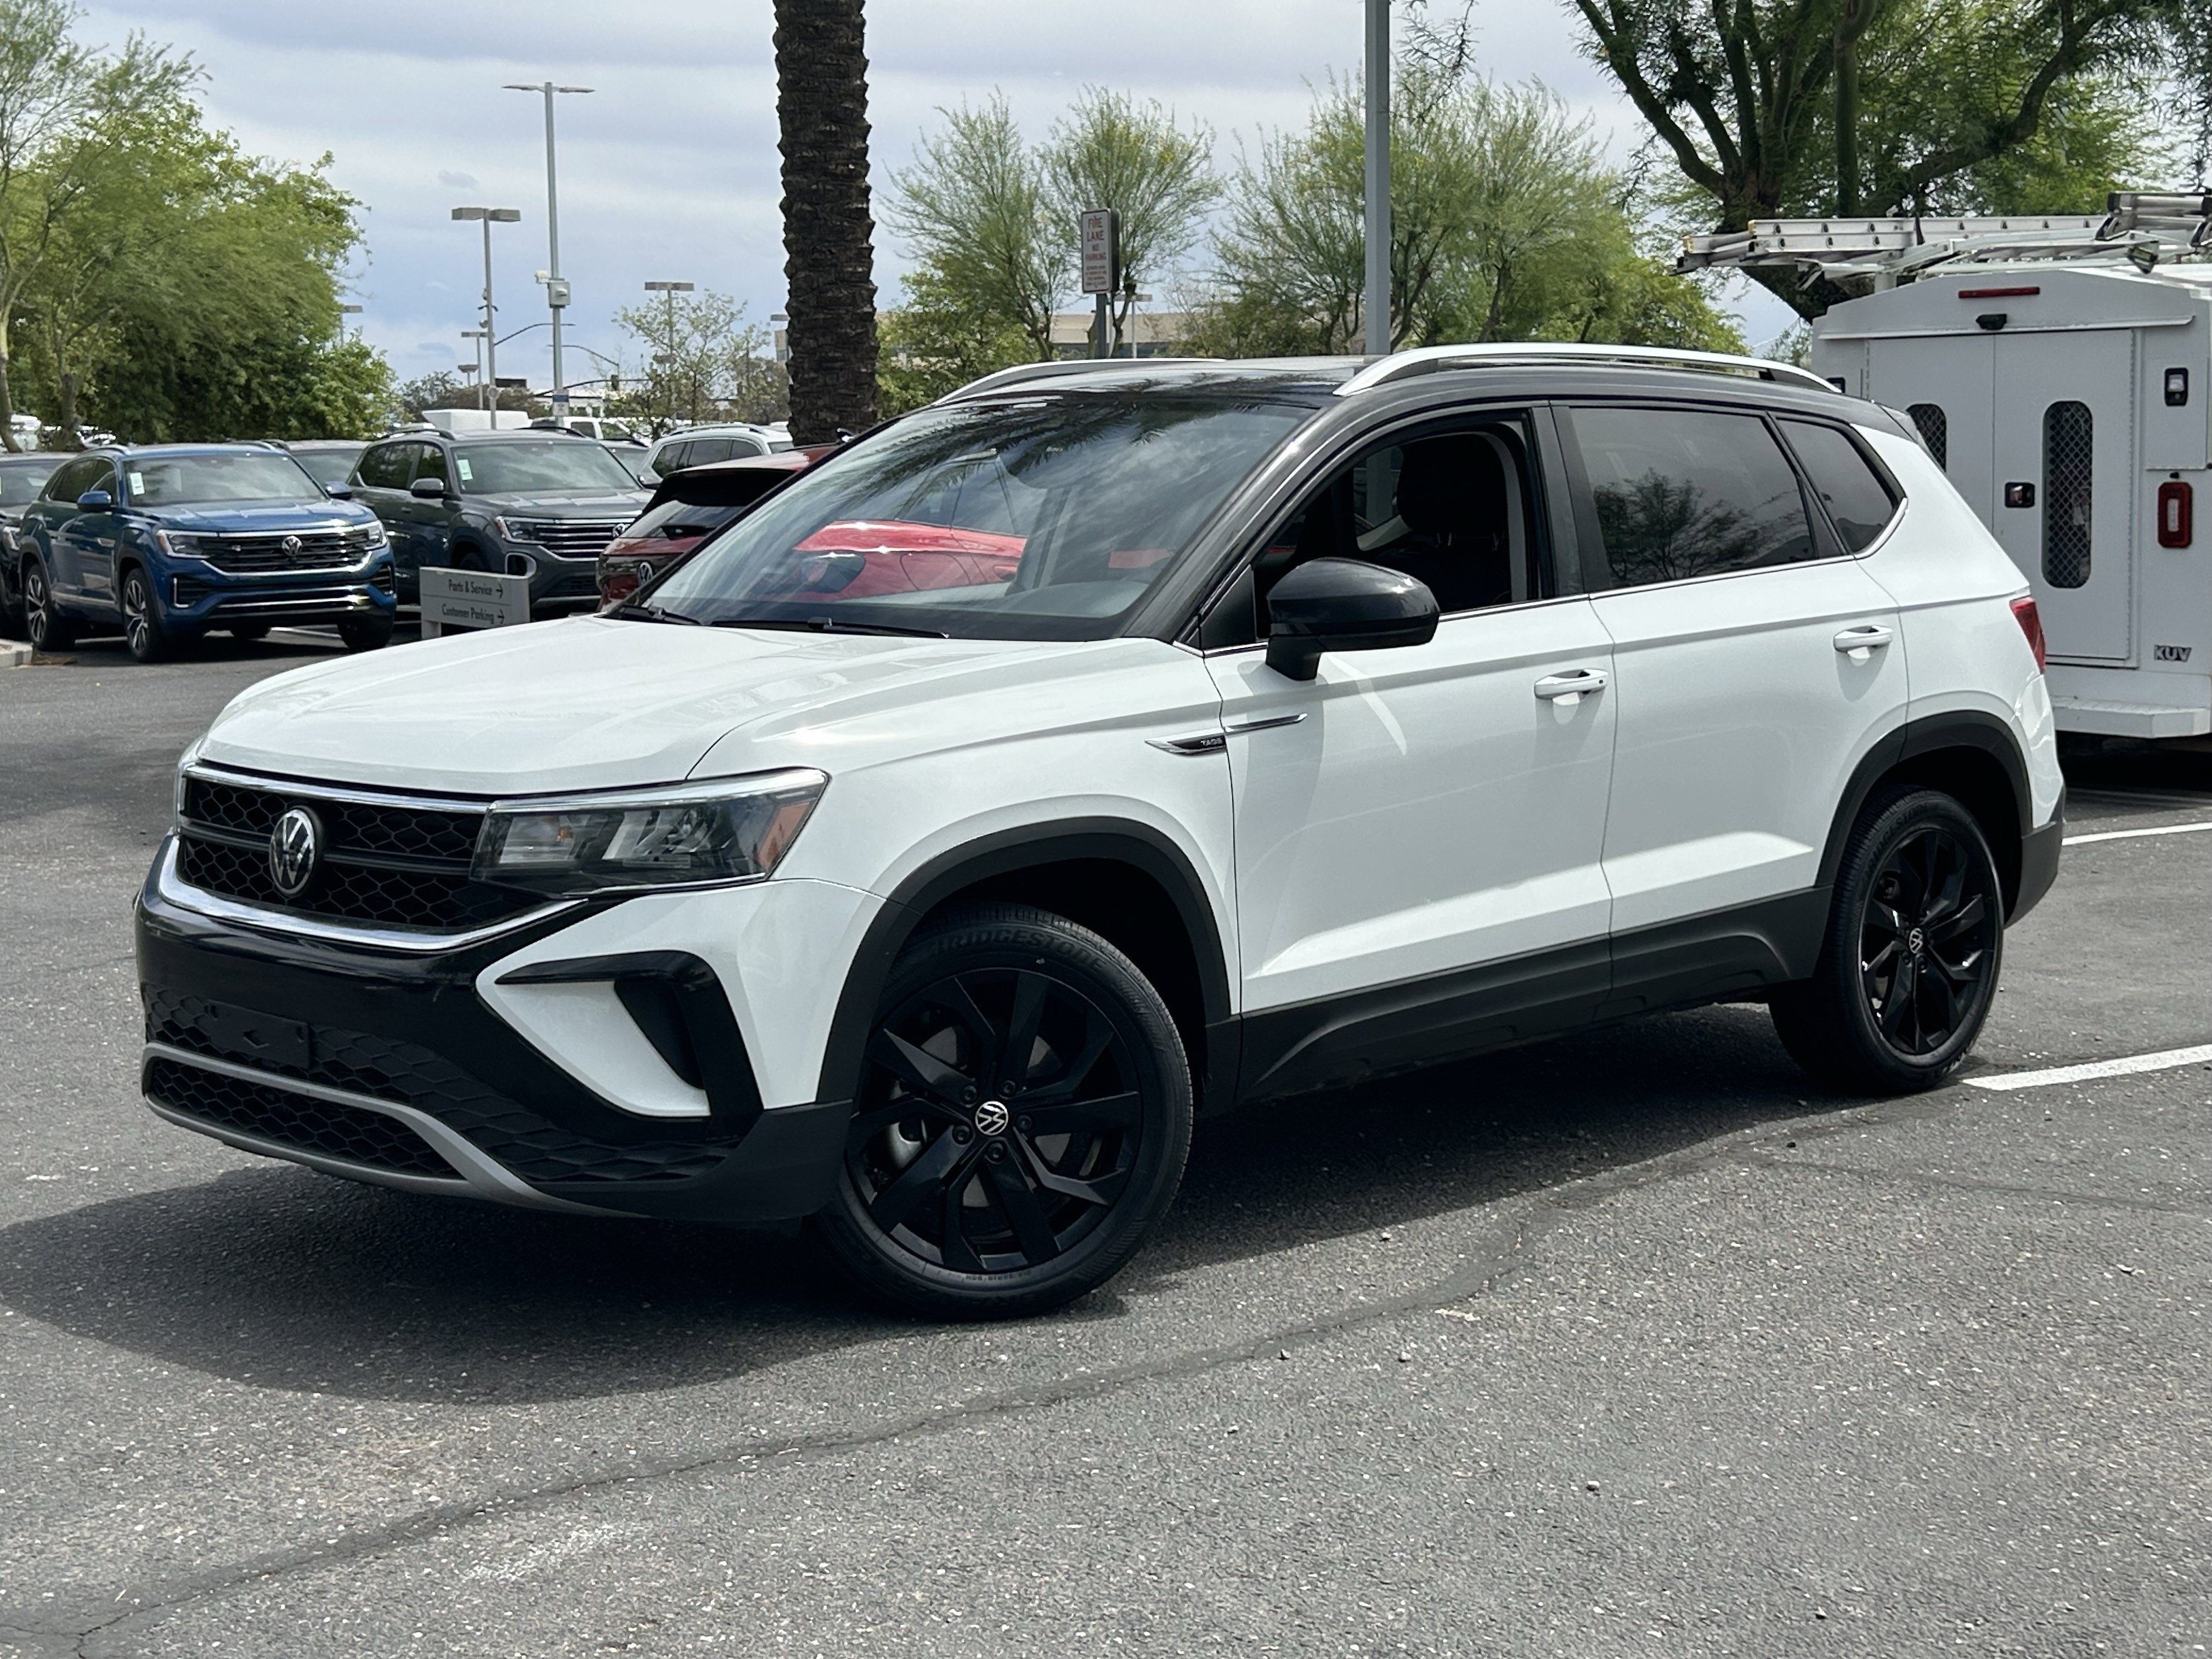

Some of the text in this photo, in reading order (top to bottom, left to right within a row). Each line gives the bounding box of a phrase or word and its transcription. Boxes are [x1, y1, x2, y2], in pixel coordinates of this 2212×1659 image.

[1087, 217, 1103, 229] FIRE
[1087, 229, 1105, 242] LANE
[448, 578, 493, 596] Parts & Service
[442, 603, 494, 625] Customer Parking
[2154, 645, 2192, 662] KUV
